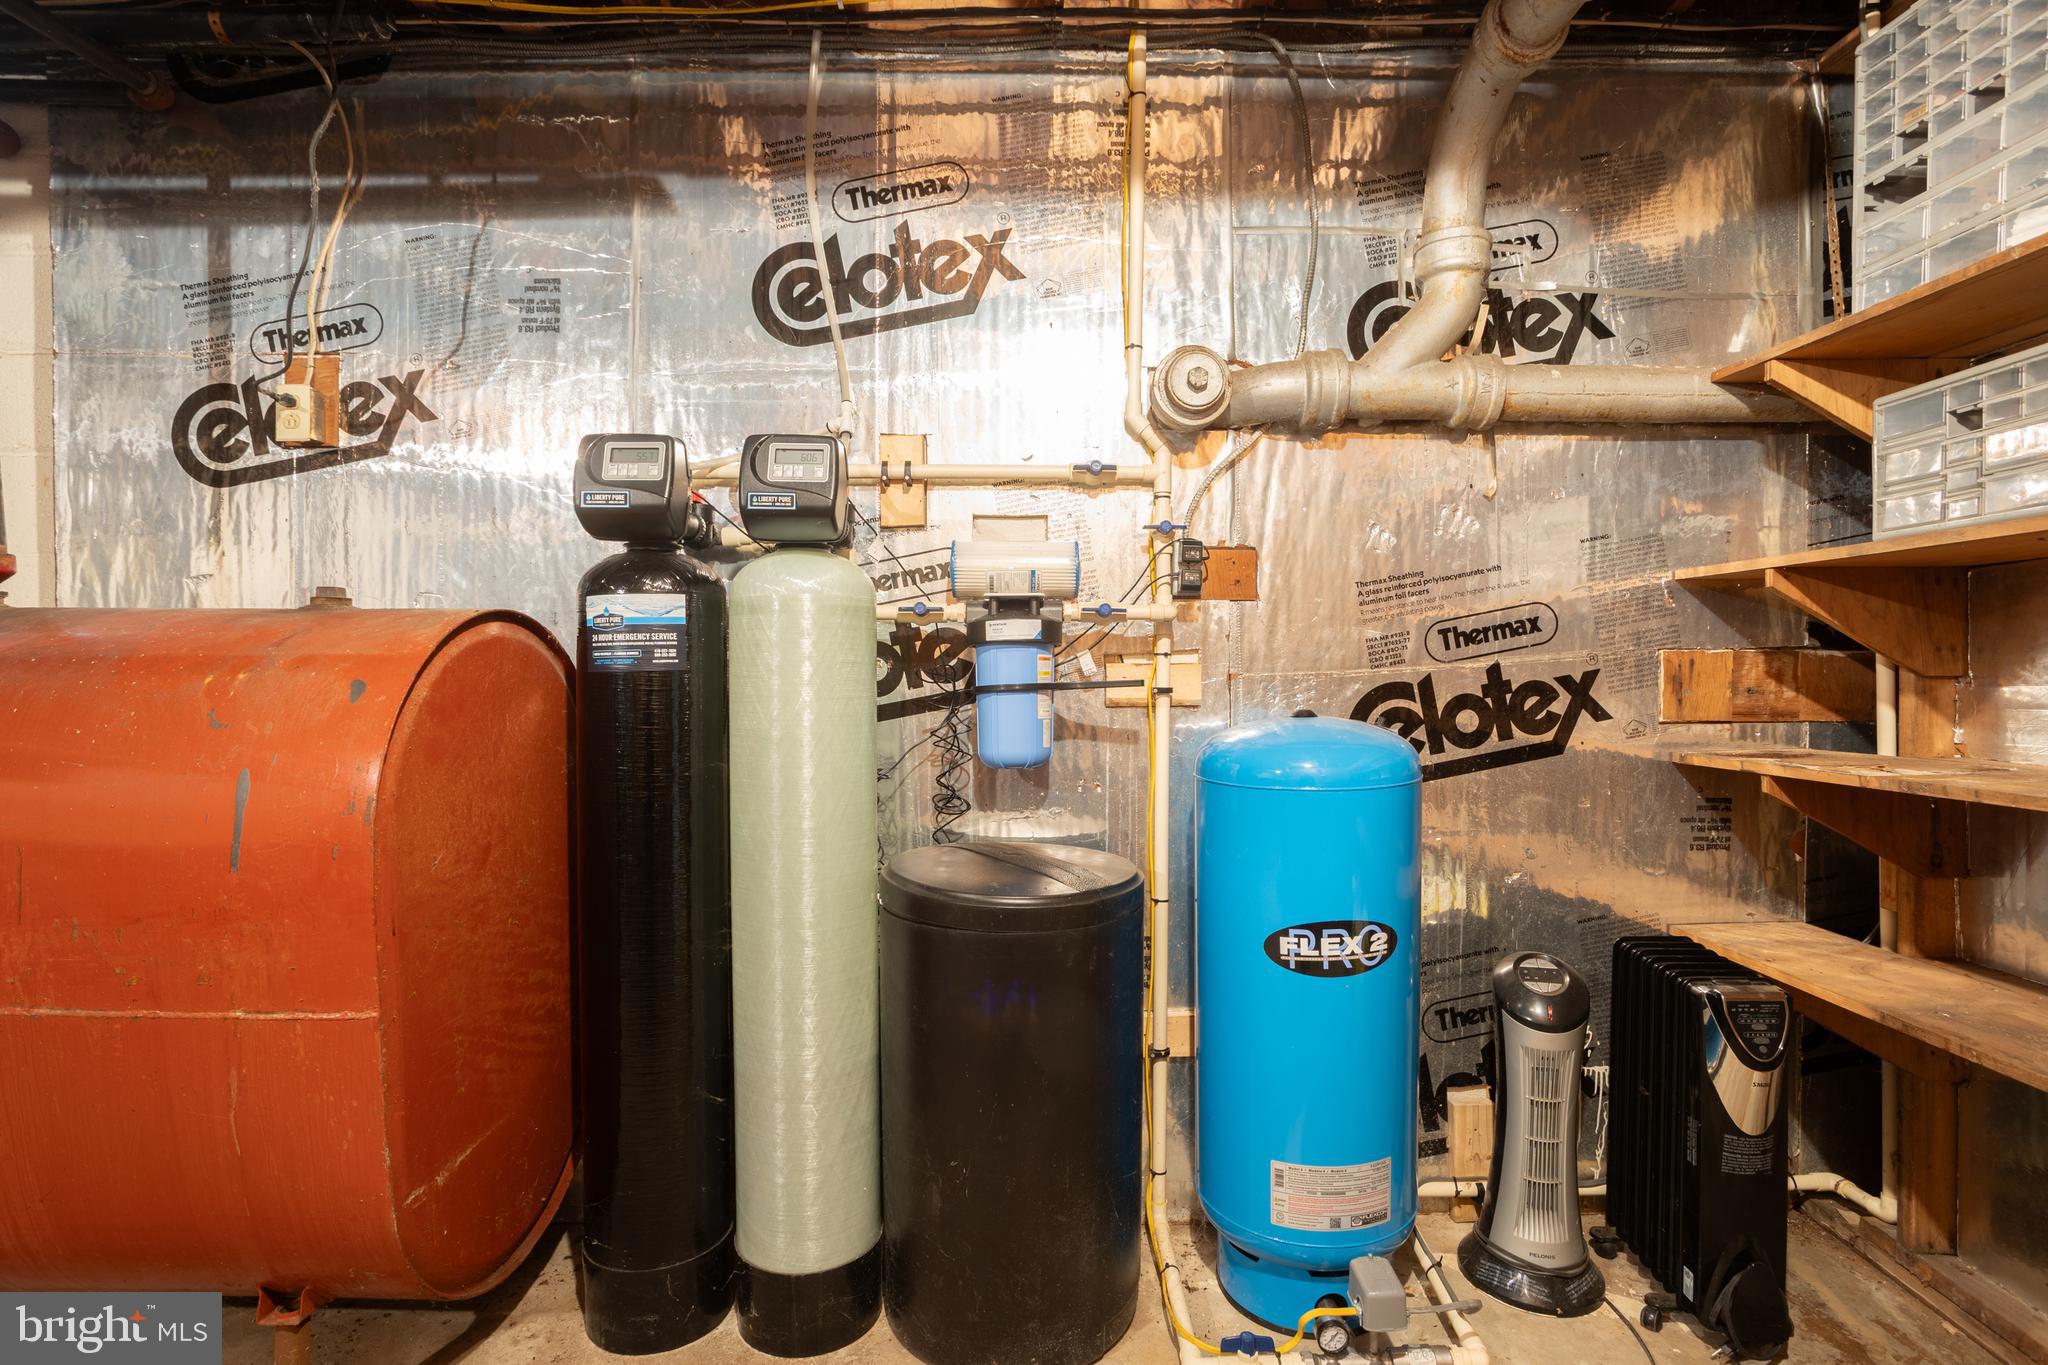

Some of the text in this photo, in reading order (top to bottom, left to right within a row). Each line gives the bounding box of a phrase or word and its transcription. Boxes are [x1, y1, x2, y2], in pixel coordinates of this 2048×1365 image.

[762, 130, 832, 150] Thermax Shthing
[763, 150, 770, 158] A
[771, 147, 789, 158] glass
[790, 140, 834, 154] reinrced
[895, 124, 911, 133] with
[765, 156, 801, 168] aluminum
[1354, 169, 1424, 189] Thermax Sheathing
[845, 174, 956, 212] Thermax
[1356, 189, 1364, 198] A
[1364, 186, 1383, 198] glass
[1486, 181, 1502, 191] with
[1358, 194, 1394, 207] aluminum
[774, 208, 792, 217] BOCA
[180, 273, 249, 292] Thermax Sheathing
[182, 270, 310, 301] A glass reinforced polyisocyanure
[752, 219, 1026, 347] Celotex
[184, 297, 220, 310] aluminum
[231, 290, 255, 302] facers
[172, 368, 439, 488] Celex
[1580, 533, 1611, 544] WARNING:
[1355, 570, 1424, 590] Thermax Sheathing
[1357, 564, 1502, 599] A glass reinforced polyisocyanurate with
[1358, 588, 1430, 608] aluminum foil facers
[598, 634, 613, 642] HOUR
[614, 633, 650, 642] EMERGENCY
[651, 632, 678, 641] SERVICE
[1365, 636, 1379, 645] FHA
[1438, 616, 1543, 651] Thermax
[1368, 649, 1386, 658] BOCA
[1370, 661, 1388, 670] CMHC
[1280, 932, 1389, 957] FLEX 2
[1484, 946, 1500, 956] with
[1528, 1252, 1556, 1260] PELONIS
